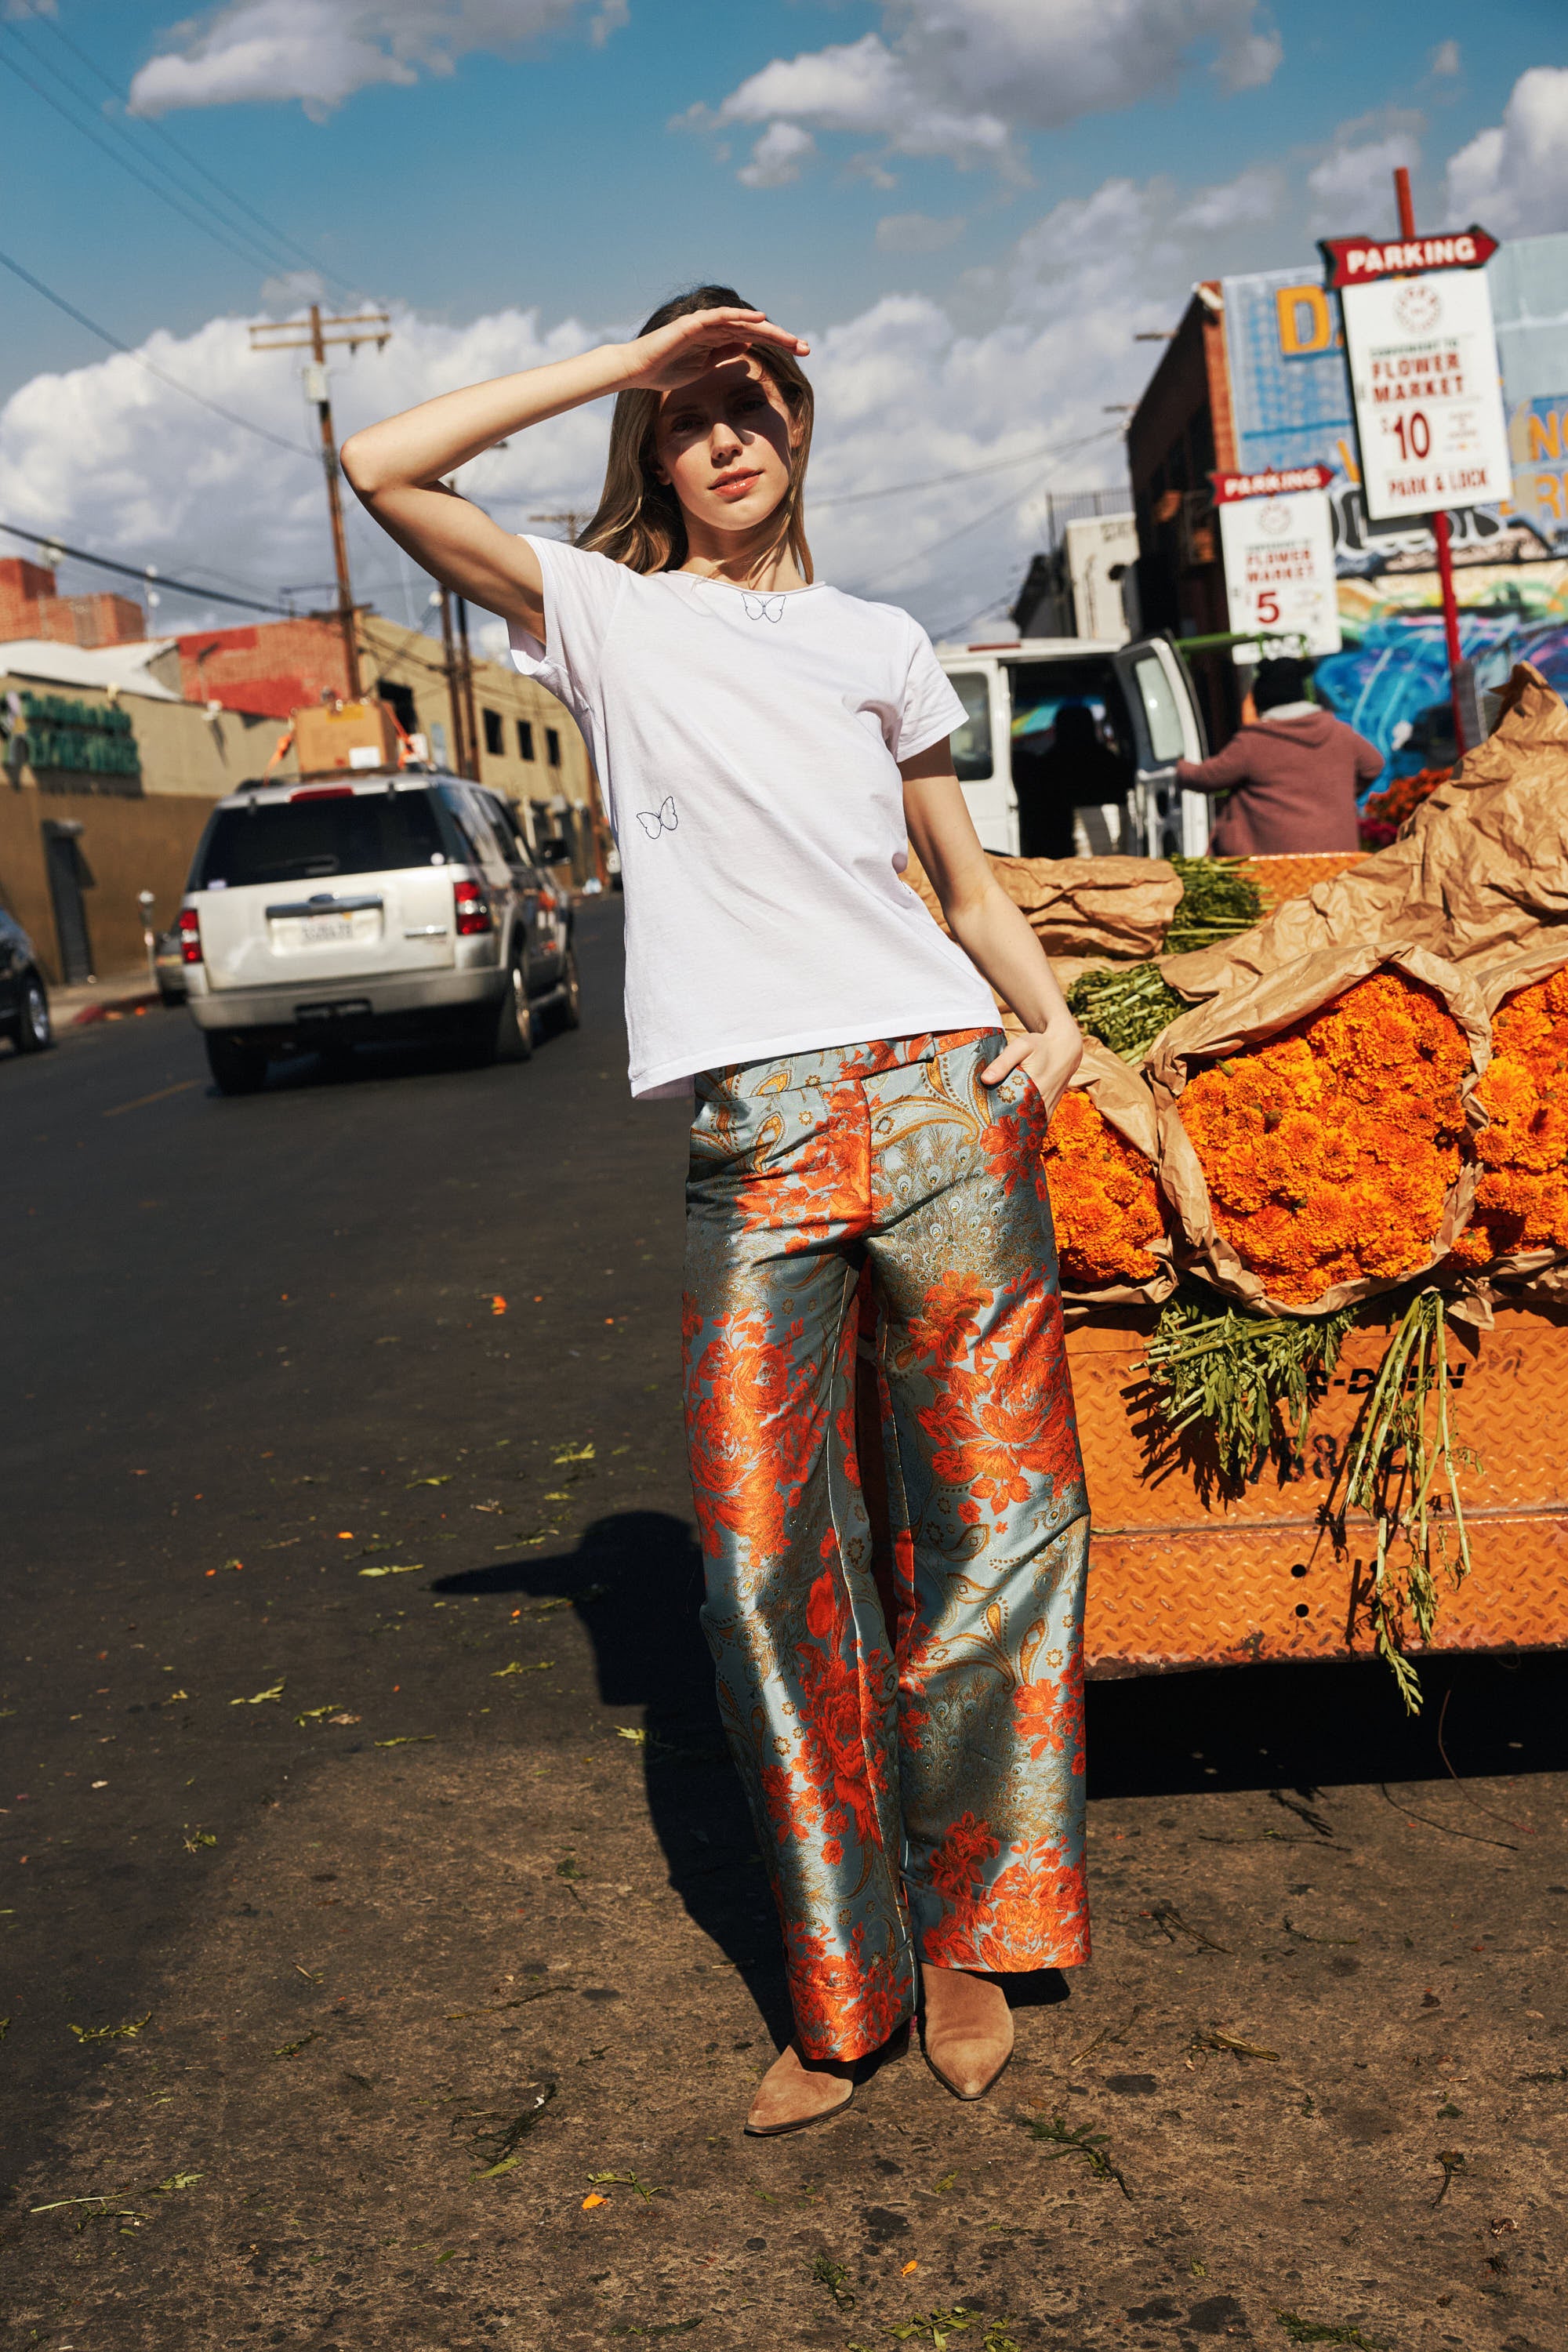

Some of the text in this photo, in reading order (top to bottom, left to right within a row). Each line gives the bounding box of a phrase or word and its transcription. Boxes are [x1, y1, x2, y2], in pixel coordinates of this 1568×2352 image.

[1347, 236, 1476, 274] PARKING
[1373, 353, 1460, 379] FLOWER
[1374, 375, 1464, 404] MARKET
[1224, 467, 1322, 497] PARKING
[1389, 467, 1487, 497] PARK & LOCK
[1247, 547, 1312, 565] FLOWER
[1247, 564, 1315, 584] MARKET
